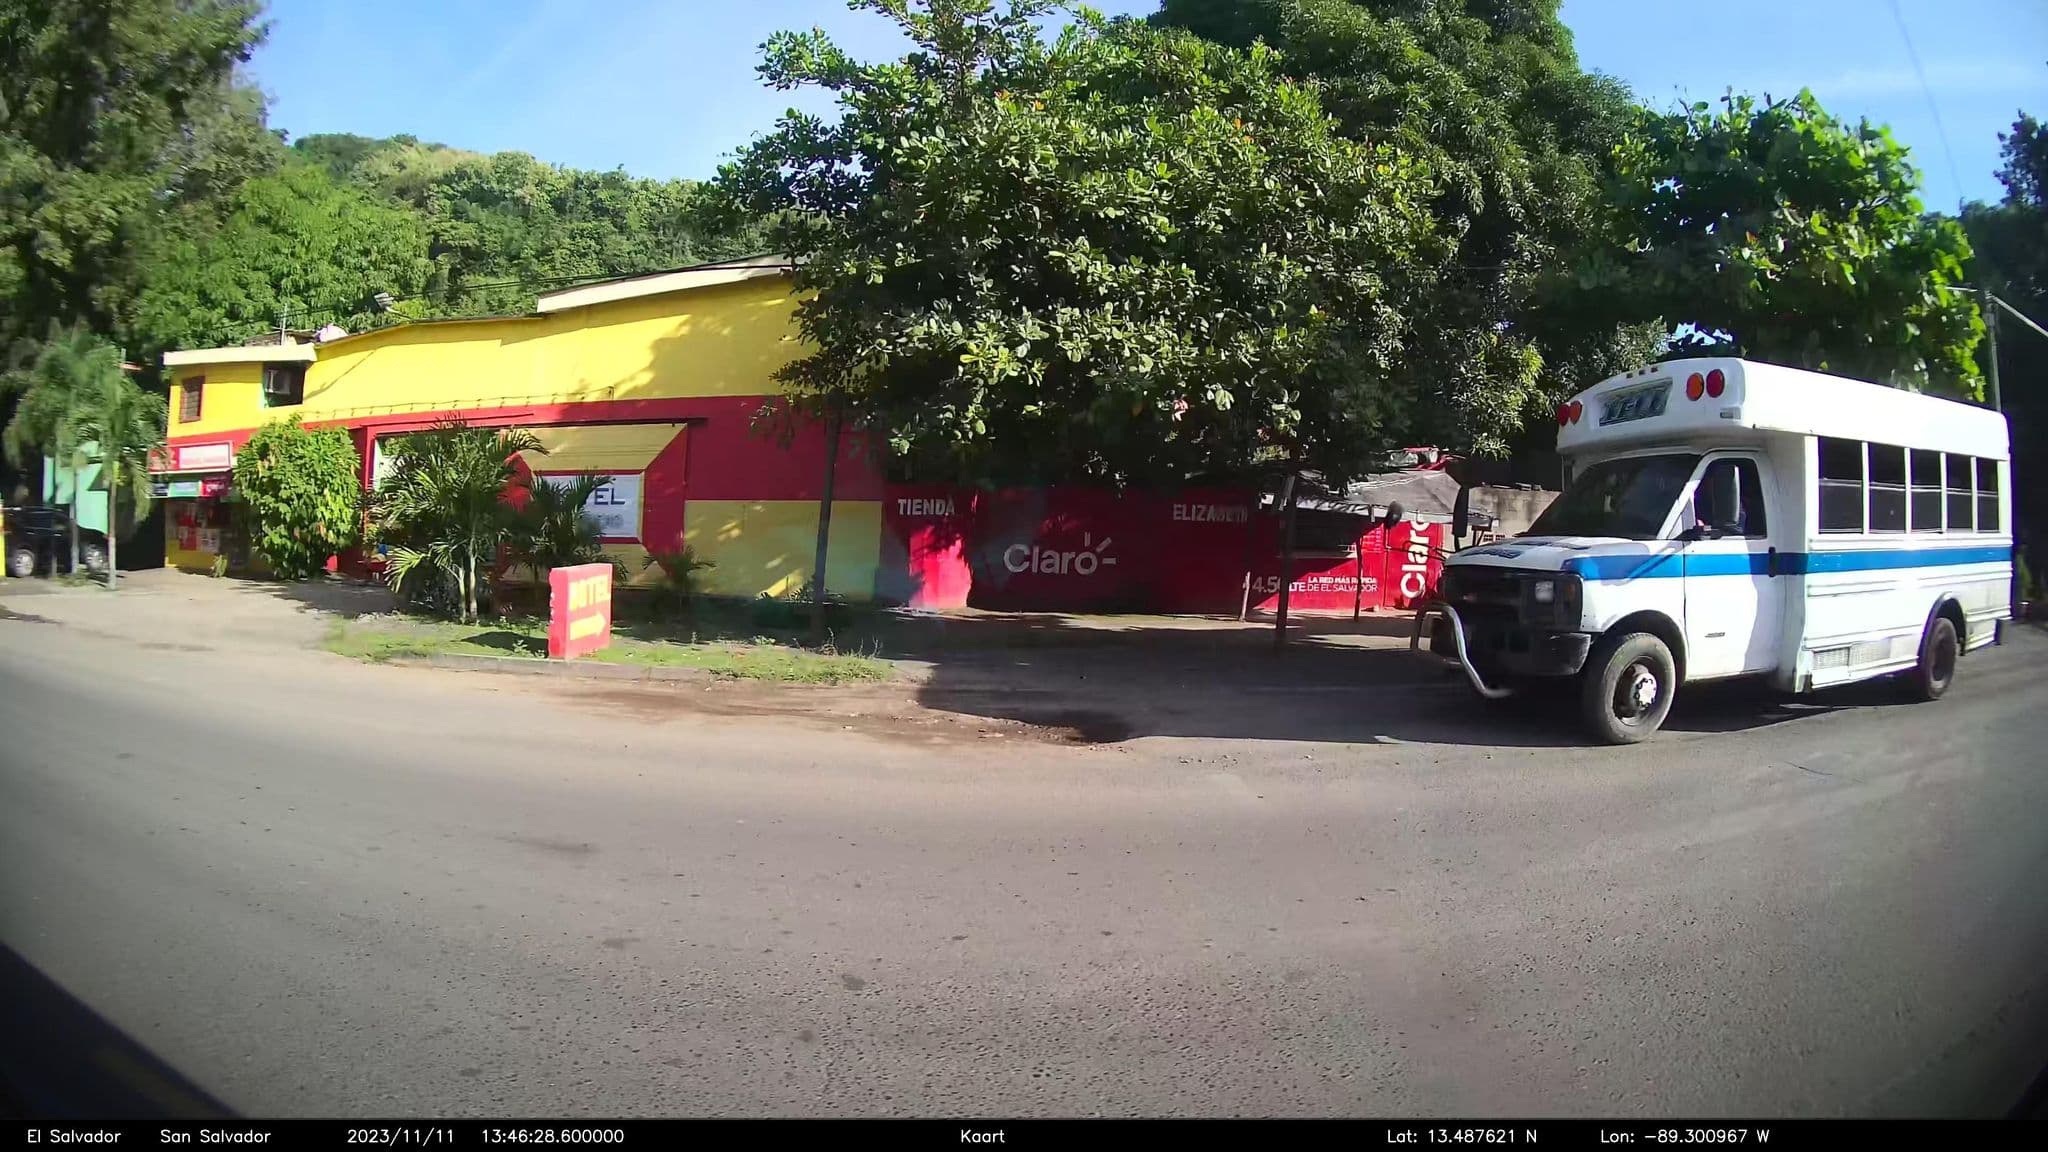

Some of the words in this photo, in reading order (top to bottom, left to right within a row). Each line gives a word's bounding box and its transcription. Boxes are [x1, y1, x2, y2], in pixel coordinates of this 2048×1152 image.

[897, 498, 955, 516] TIENDA
[1003, 543, 1099, 575] Claro
[1308, 576, 1318, 584] LA
[1319, 576, 1334, 584] RED
[1307, 583, 1320, 593] DE
[1320, 583, 1332, 593] EL
